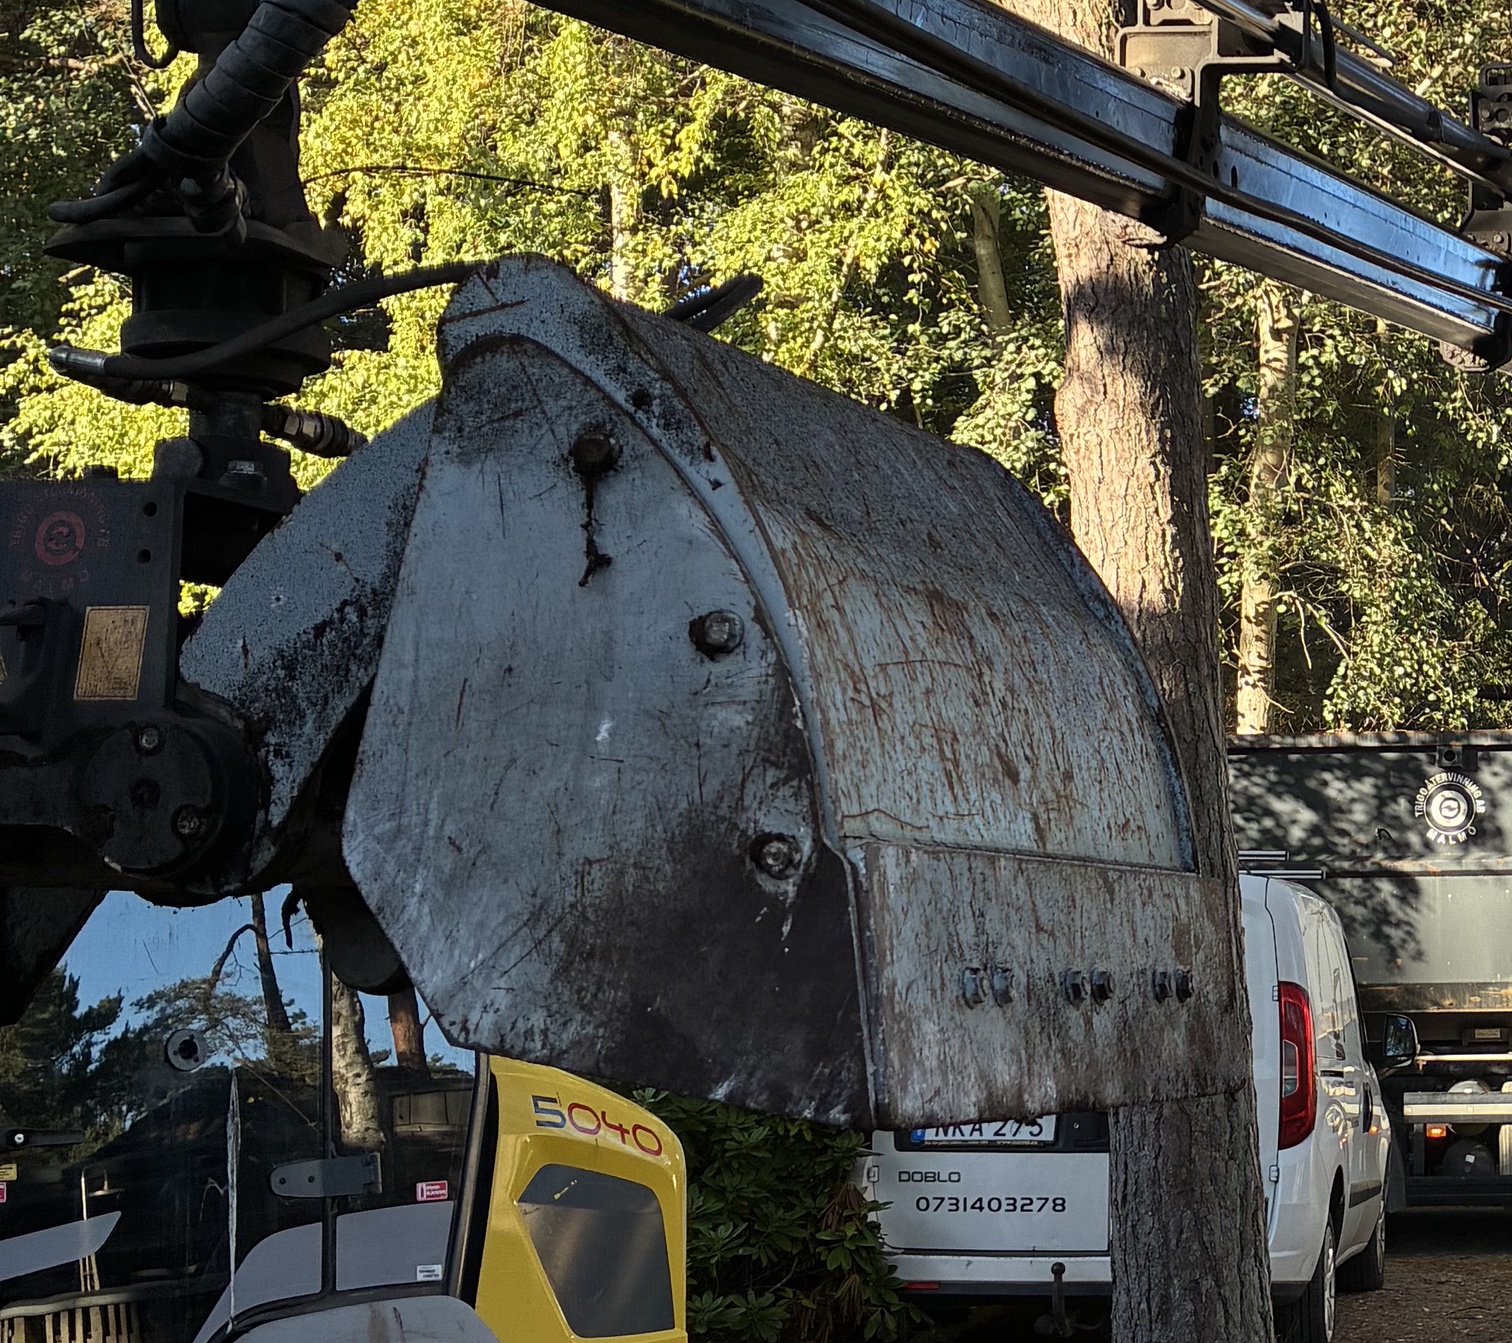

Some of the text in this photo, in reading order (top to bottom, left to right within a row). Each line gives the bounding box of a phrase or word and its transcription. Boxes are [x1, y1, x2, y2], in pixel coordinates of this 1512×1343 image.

[1476, 799, 1487, 814] AB
[531, 1094, 663, 1157] 5040
[898, 1170, 961, 1183] DOBLO
[915, 1196, 1067, 1213] 0731403278
